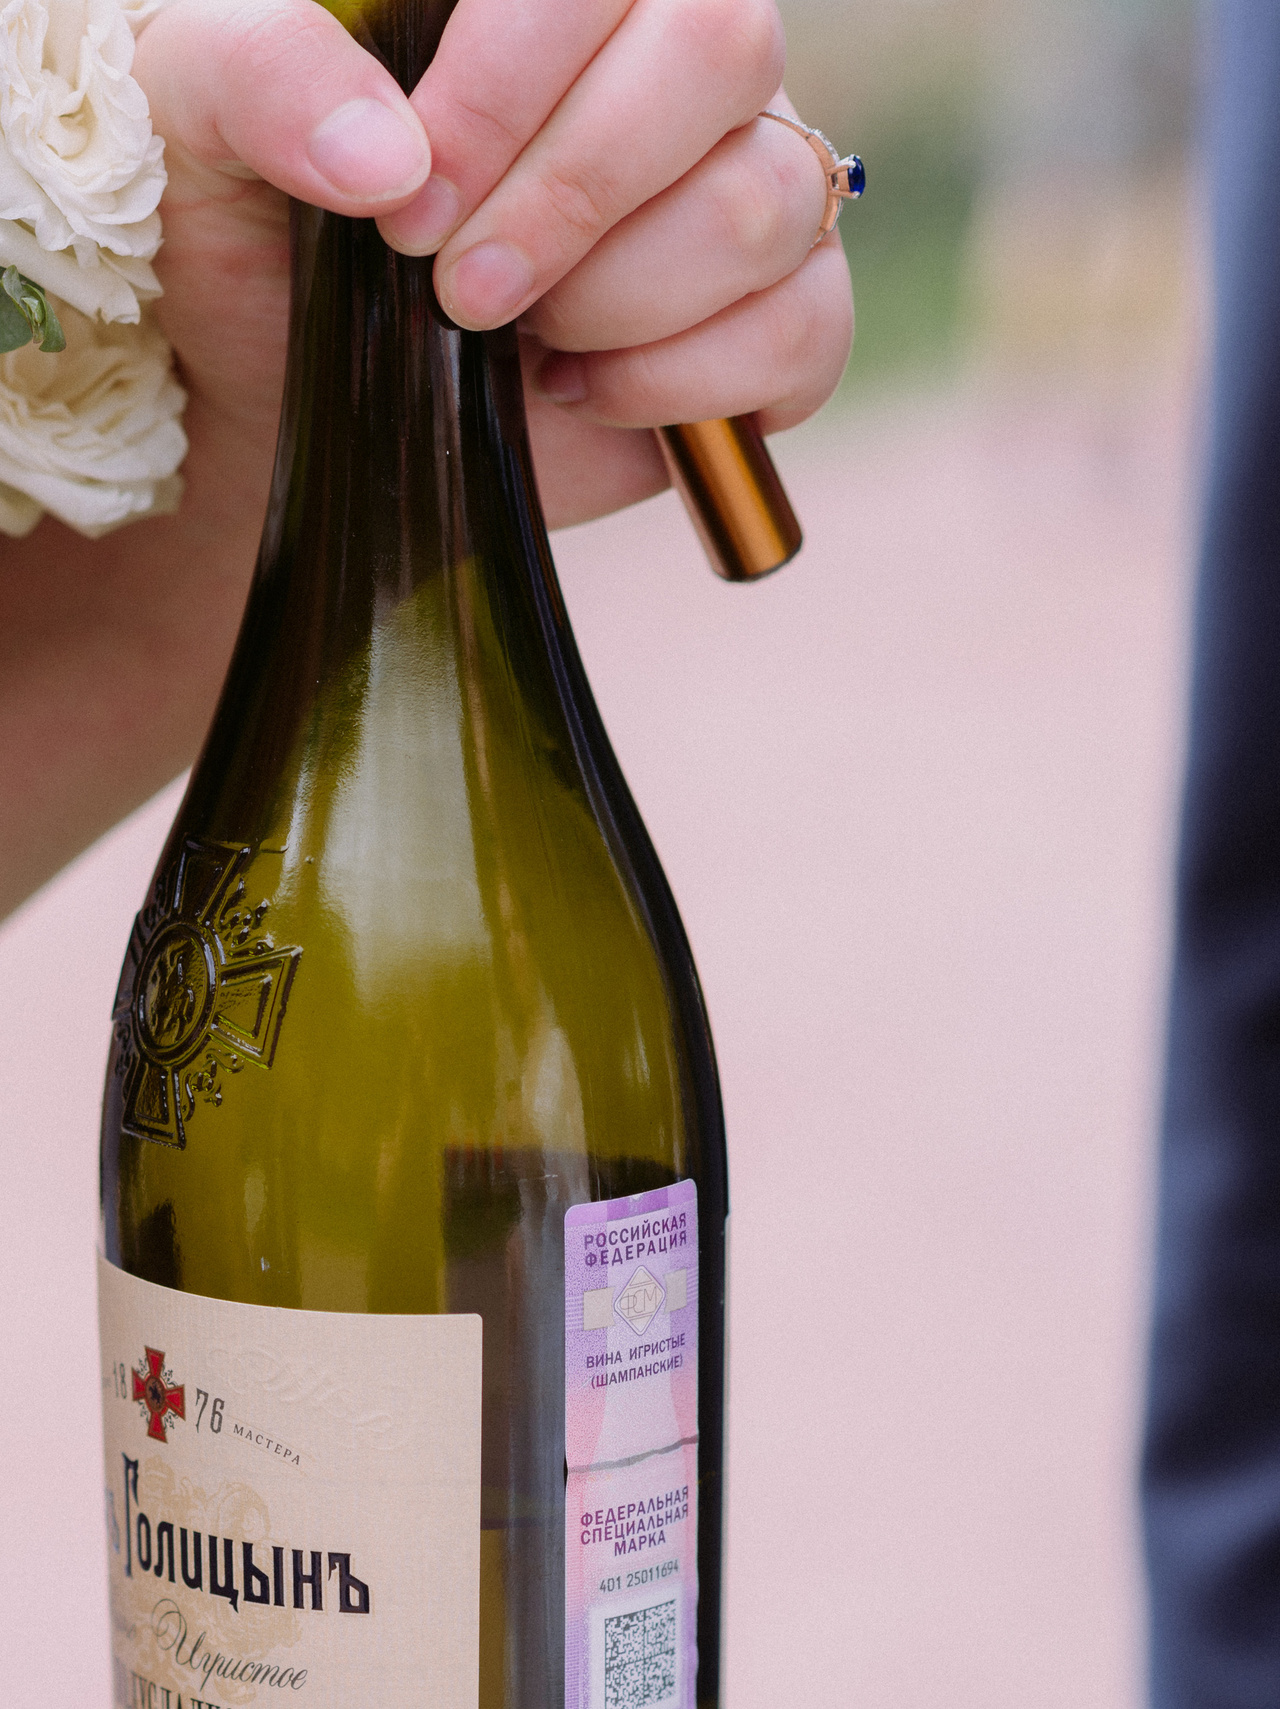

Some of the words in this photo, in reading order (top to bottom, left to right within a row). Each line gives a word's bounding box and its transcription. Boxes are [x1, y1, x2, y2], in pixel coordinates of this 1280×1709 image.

[584, 1212, 687, 1251] РОССИЙСКАЯ
[584, 1230, 687, 1268] ФЕДЕРАЦИЯ
[619, 1286, 658, 1316] ФСМ
[586, 1350, 623, 1369] ВИНА
[629, 1333, 686, 1361] ИГРИСТЫЕ
[591, 1354, 684, 1390] (ШАМПАНСКИЕ)
[195, 1387, 226, 1435] 76
[232, 1423, 301, 1466] МАСТЕРА
[580, 1485, 689, 1528] ФЕДЕРАЛЬНАЯ
[580, 1503, 689, 1546] СПЕЦИАЛЬНАЯ
[614, 1530, 666, 1557] МАРКА
[599, 1575, 622, 1593] 401
[626, 1559, 679, 1588] 25011694
[151, 1598, 309, 1693] Игристое
